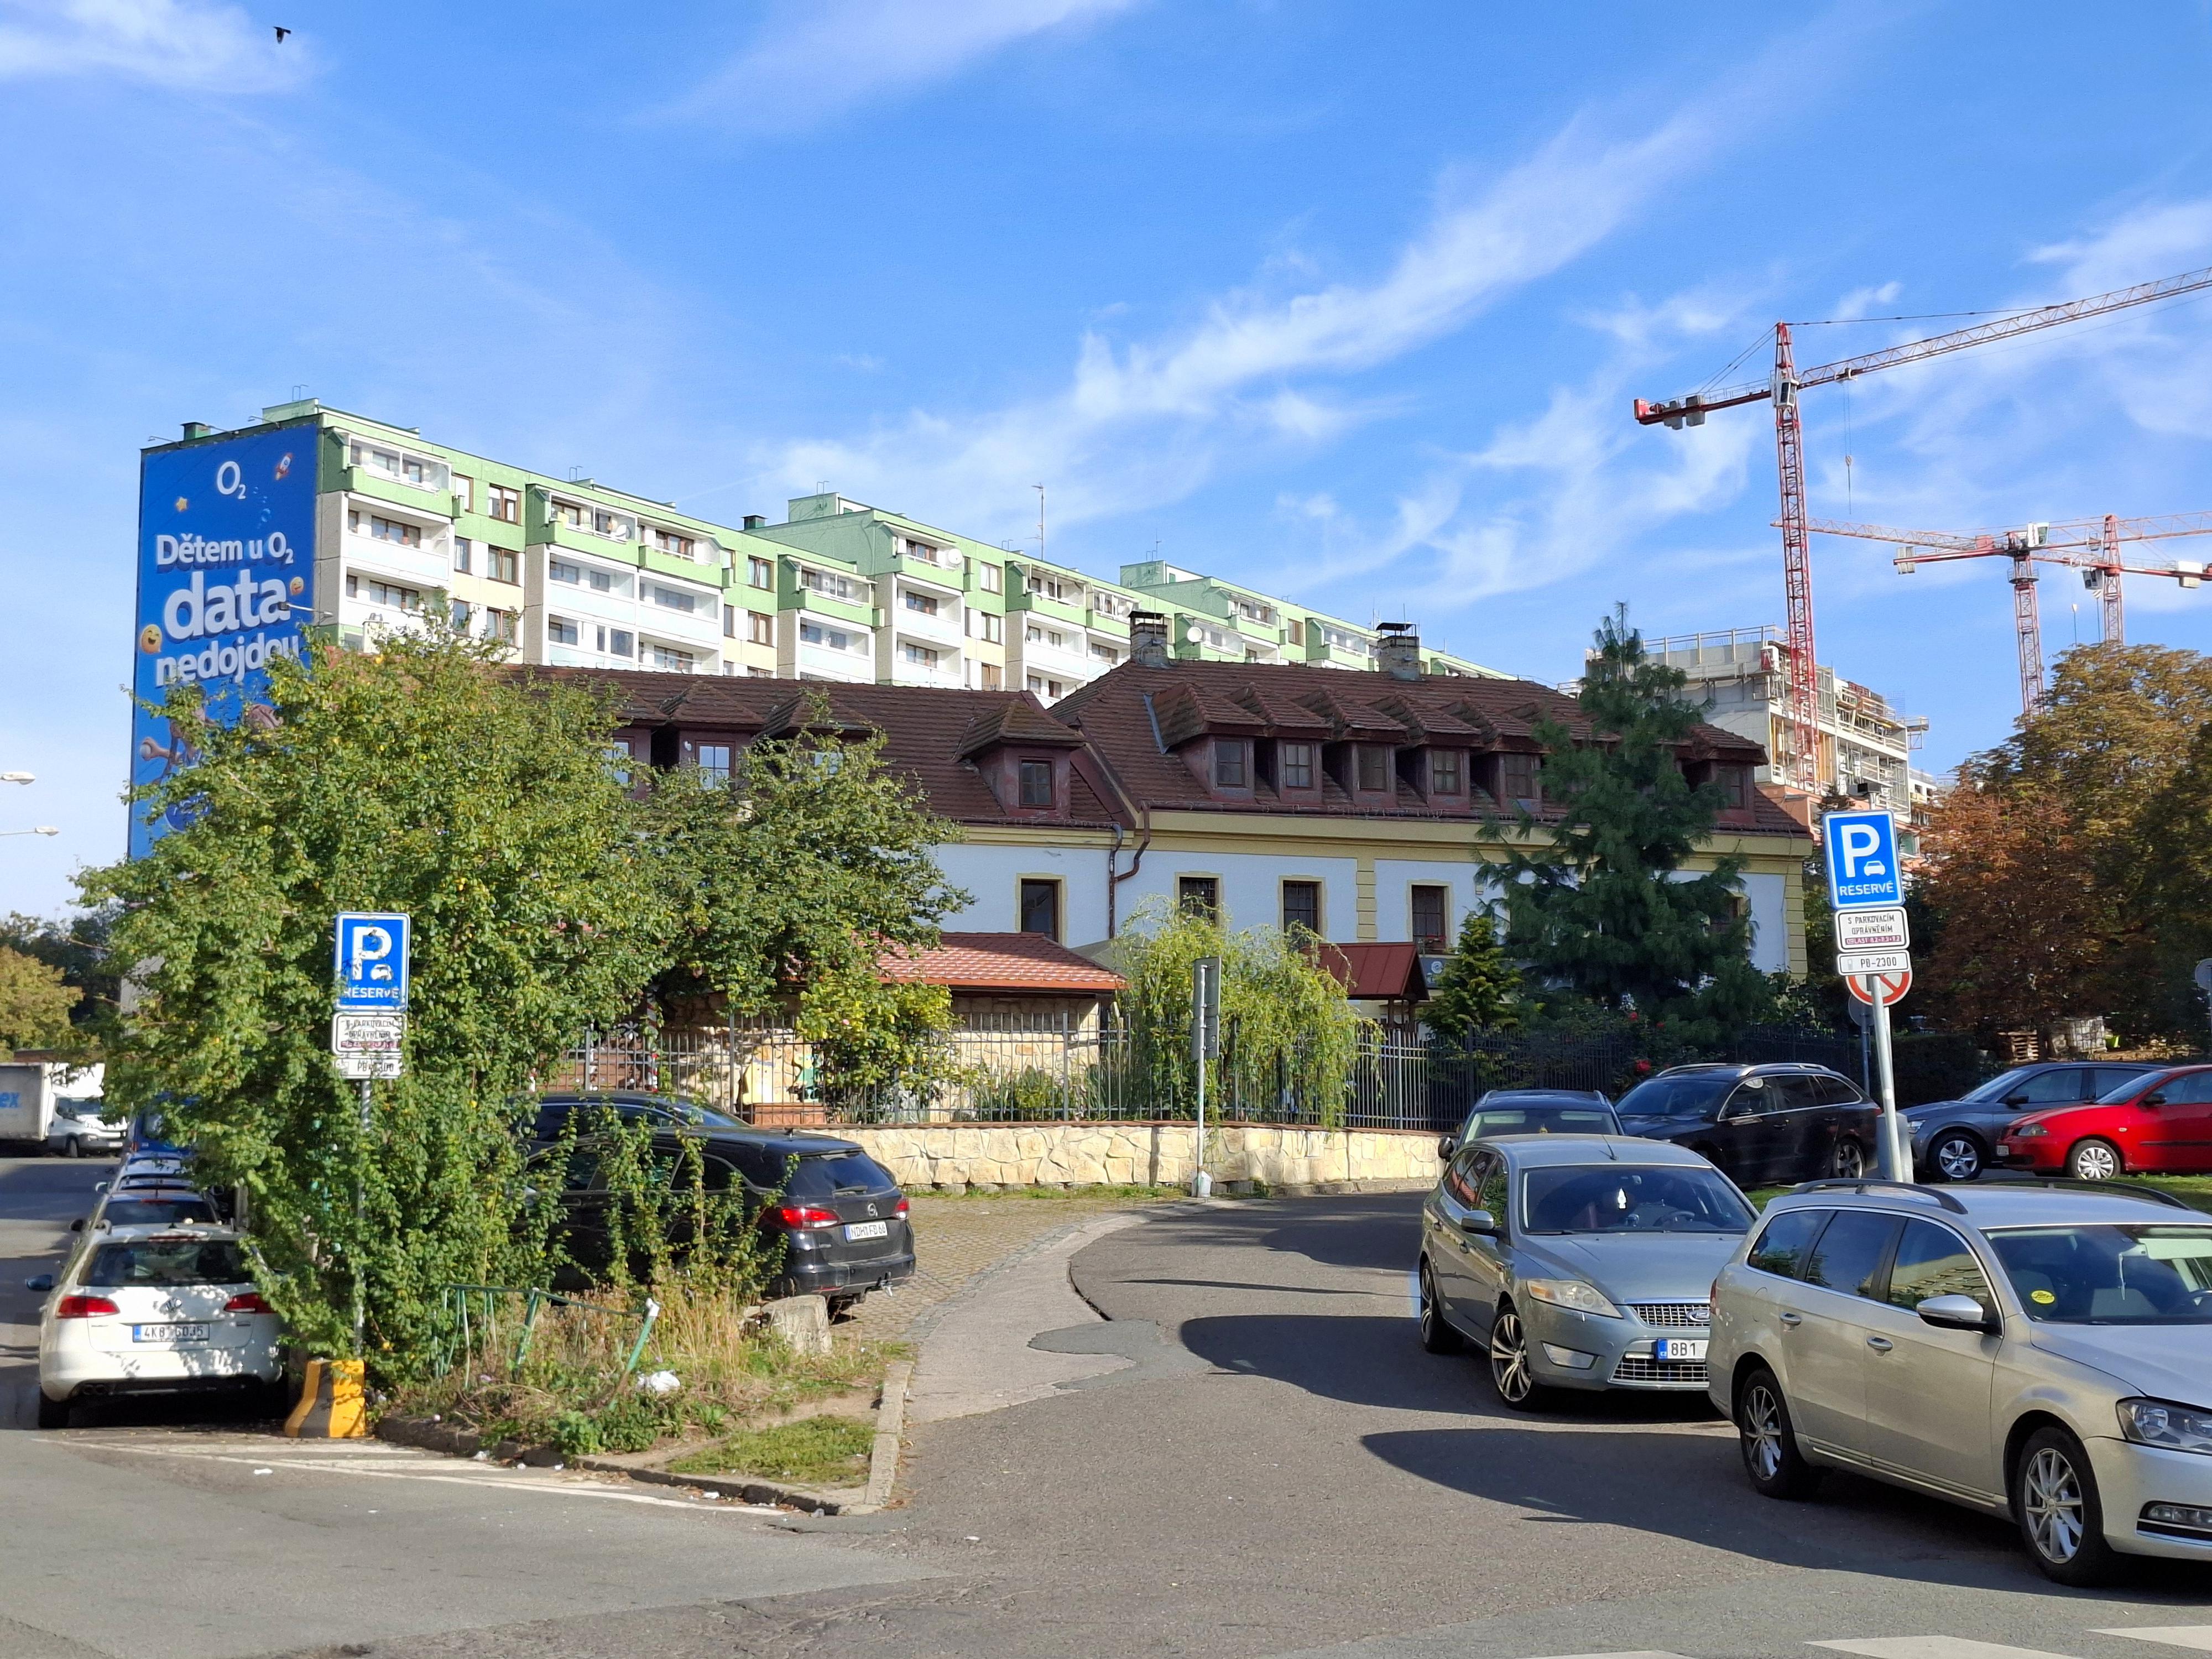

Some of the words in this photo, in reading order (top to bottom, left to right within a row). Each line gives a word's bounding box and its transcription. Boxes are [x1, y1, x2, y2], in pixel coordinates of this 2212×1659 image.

[156, 533, 243, 565] Dětem
[249, 539, 263, 559] u
[164, 568, 291, 639] data
[156, 632, 300, 687] nedojdou
[1841, 824, 1880, 878] P
[353, 926, 392, 980] P
